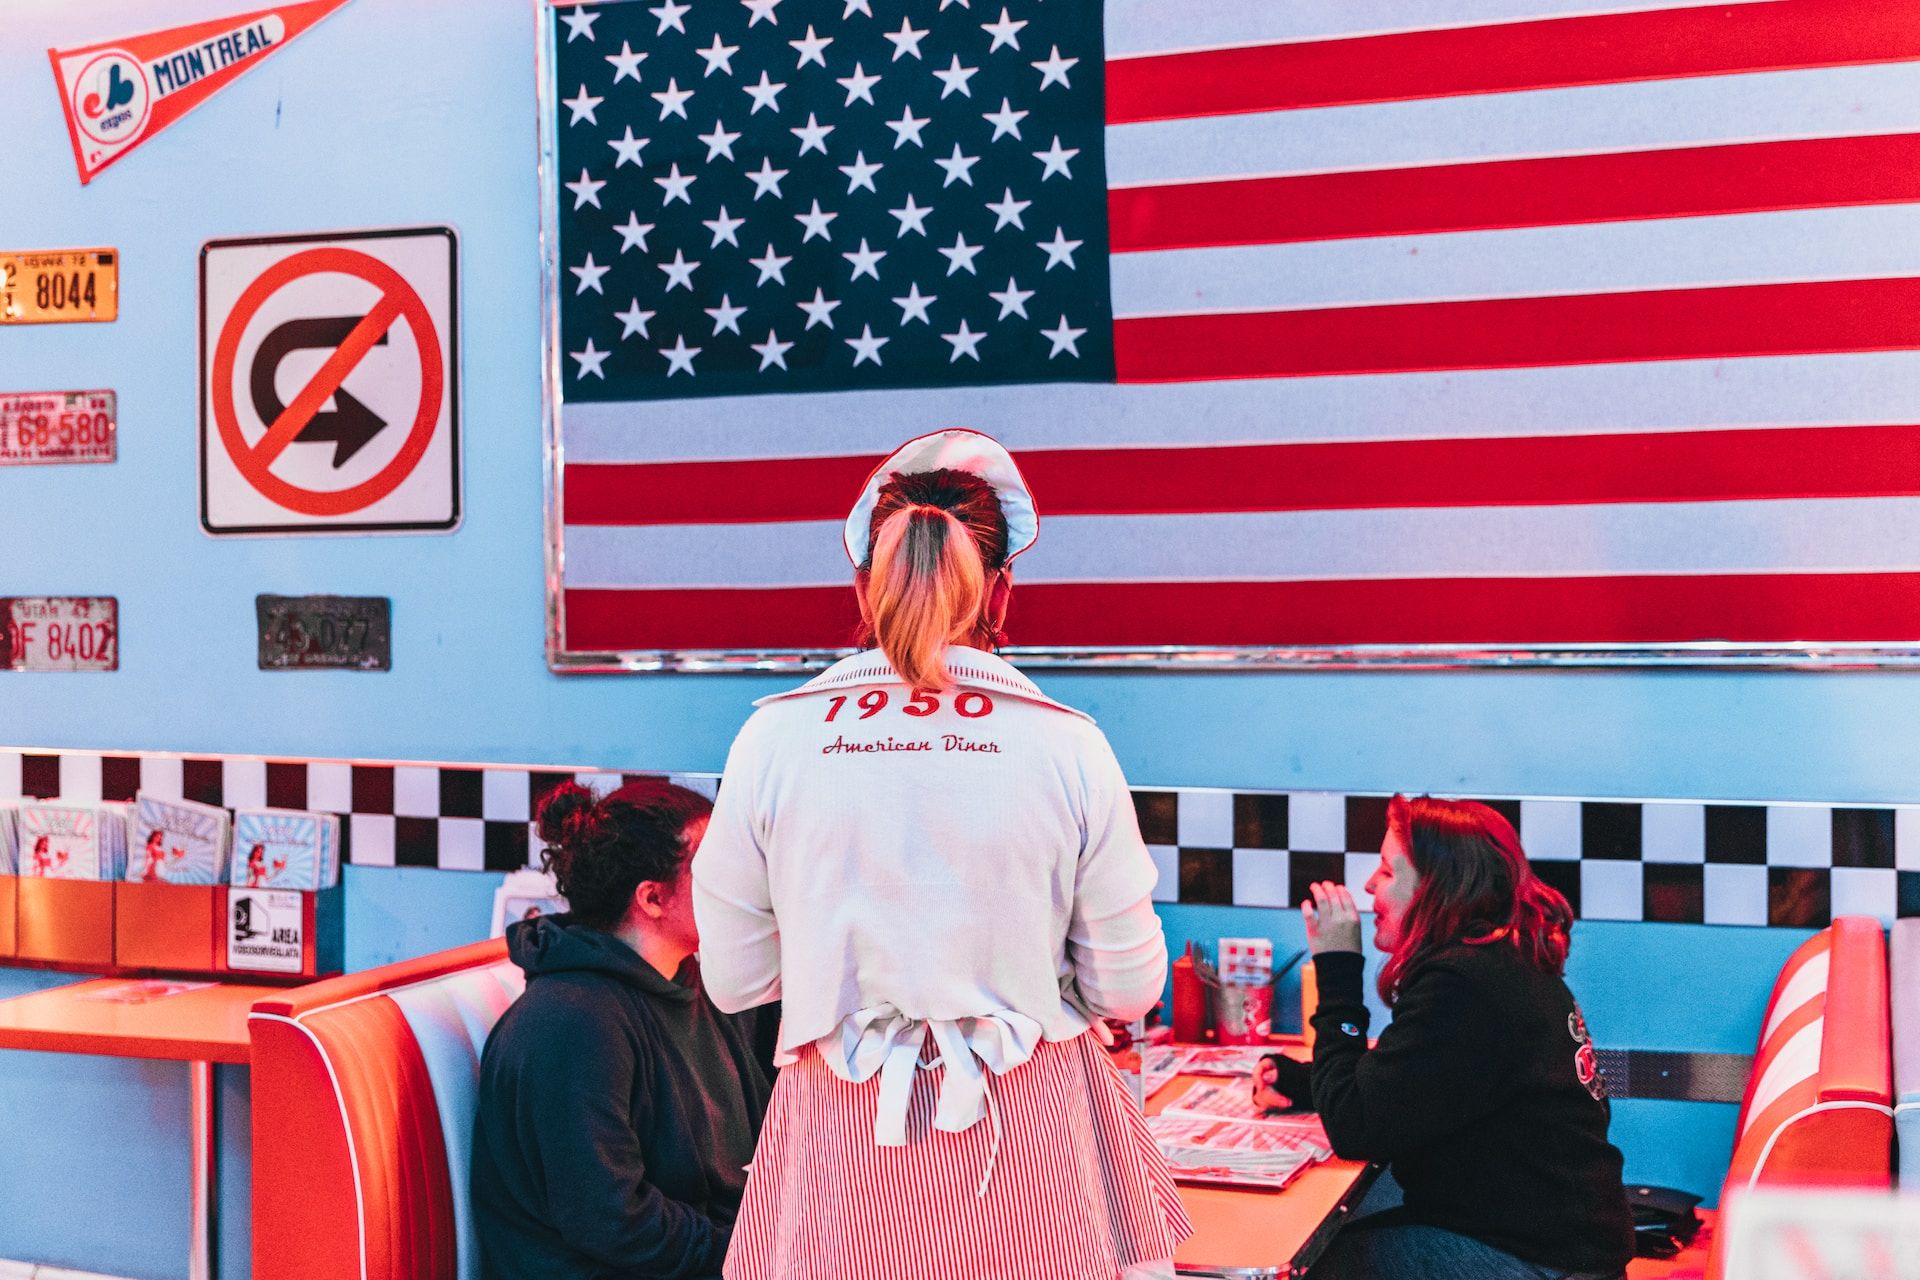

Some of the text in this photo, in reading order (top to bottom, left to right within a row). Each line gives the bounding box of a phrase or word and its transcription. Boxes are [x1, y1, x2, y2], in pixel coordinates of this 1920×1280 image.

[153, 24, 272, 95] MONTREAL
[36, 271, 97, 310] 8044
[48, 621, 110, 661] 8402
[824, 687, 994, 723] 1950
[822, 734, 1002, 755] American Diner
[272, 928, 299, 944] AREA
